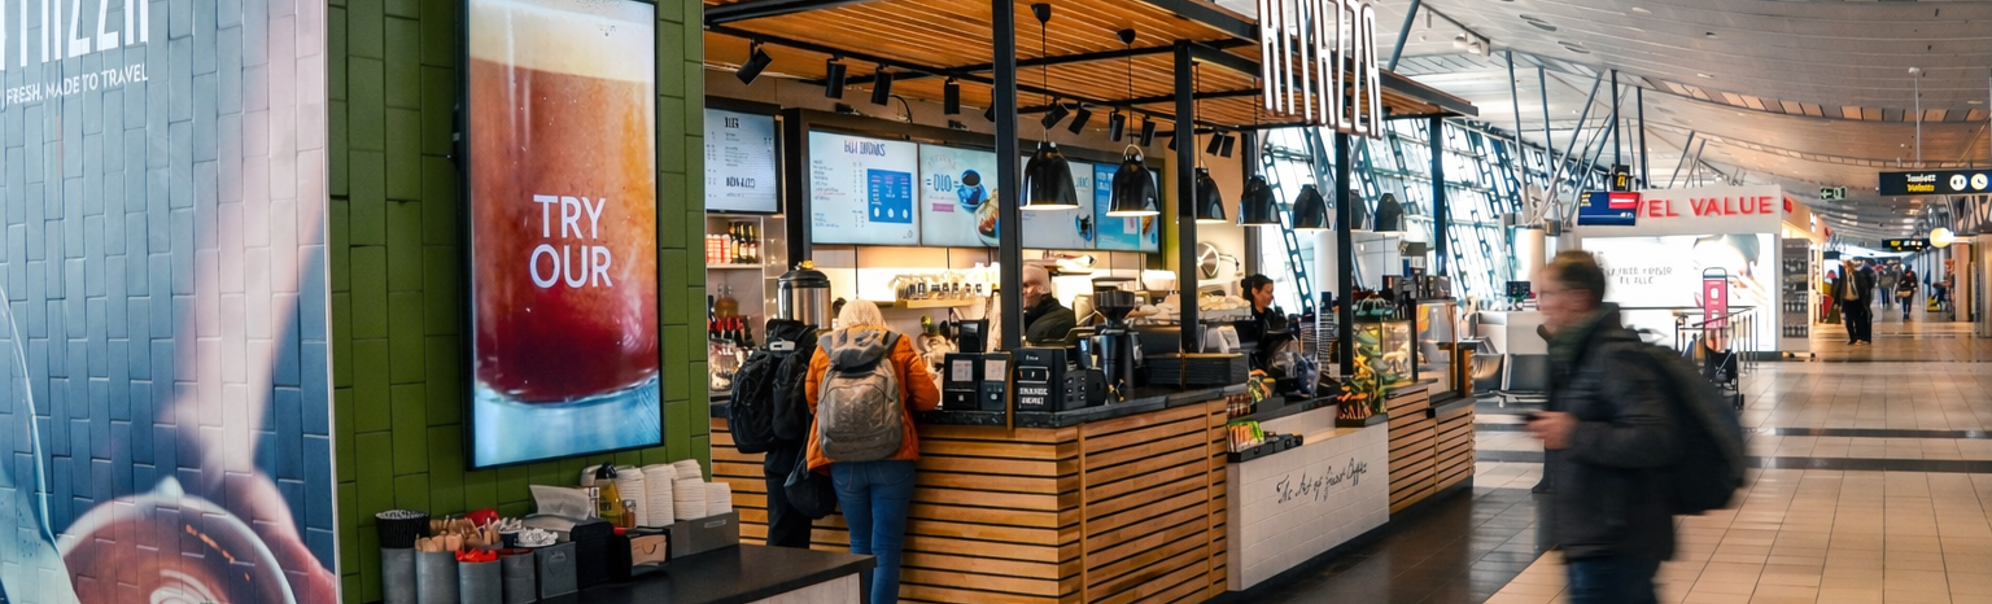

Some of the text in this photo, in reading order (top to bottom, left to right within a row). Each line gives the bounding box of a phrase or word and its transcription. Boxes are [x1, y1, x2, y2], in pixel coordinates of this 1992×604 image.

[46, 76, 80, 100] MADE
[82, 72, 98, 93] TO
[101, 62, 149, 89] TRAVEL
[533, 194, 607, 240] TRY
[1690, 195, 1774, 217] VALUE
[529, 243, 613, 289] OUR
[1276, 474, 1293, 504] The
